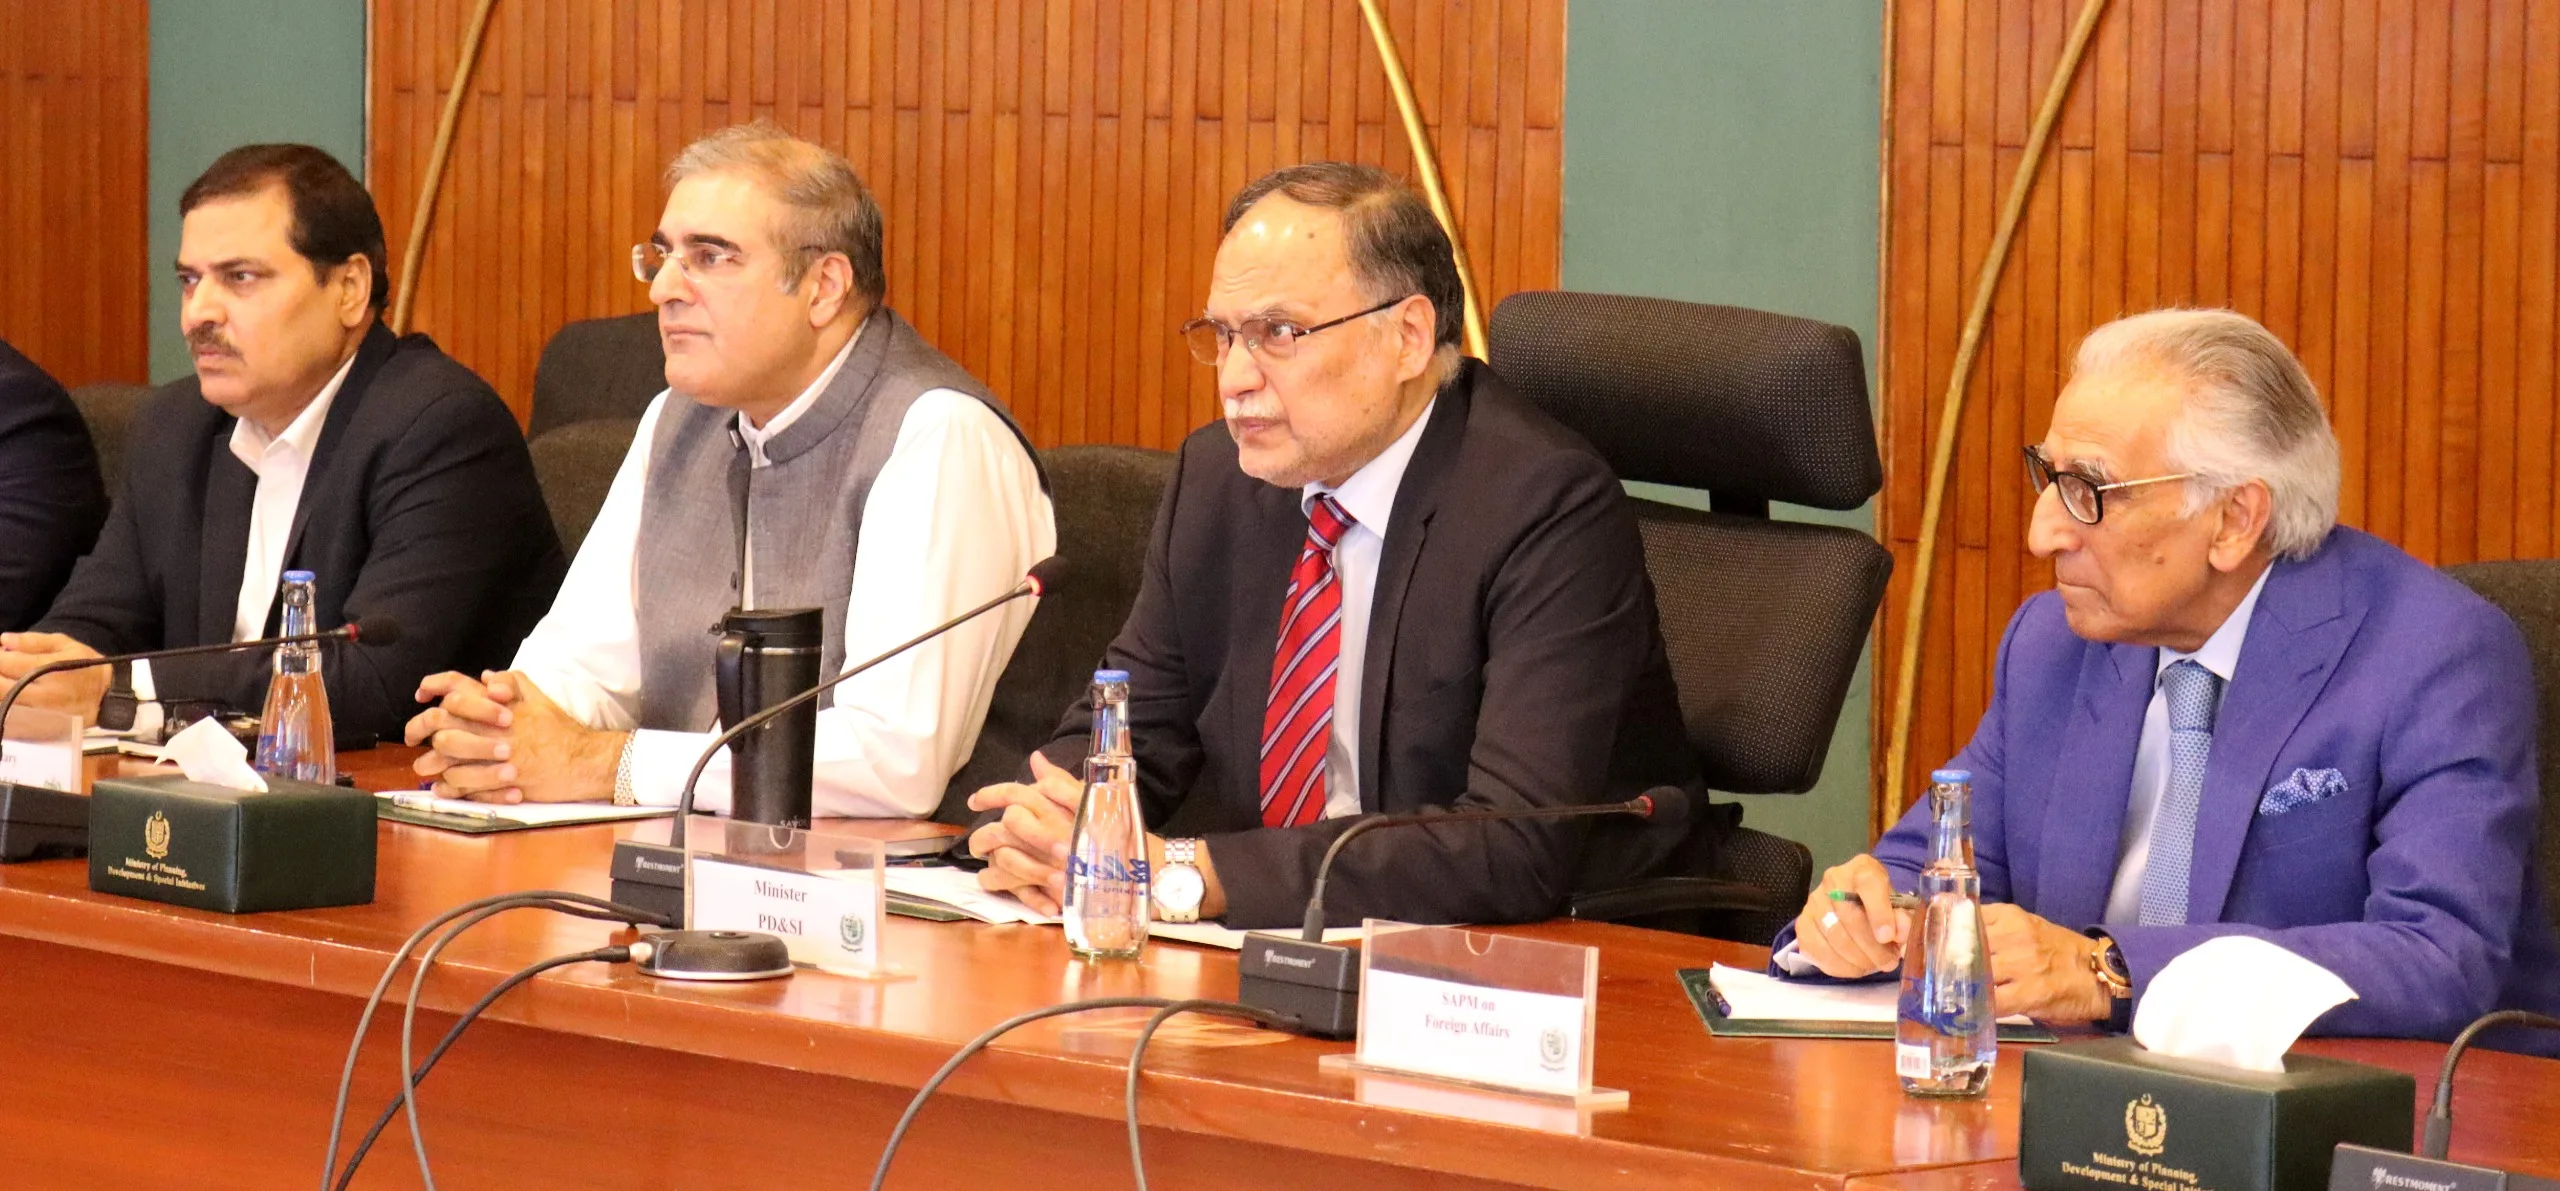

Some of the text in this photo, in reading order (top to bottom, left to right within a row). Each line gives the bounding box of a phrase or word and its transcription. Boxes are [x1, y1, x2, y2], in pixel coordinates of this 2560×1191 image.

[754, 879, 808, 902] Minister
[758, 913, 803, 936] PD&SI
[1441, 991, 1495, 1012] SAPM on
[1425, 1014, 1510, 1038] Foreign Affairs
[2061, 1161, 2127, 1183] Development
[2129, 1173, 2139, 1185] &
[2141, 1175, 2177, 1191] Special
[2092, 1151, 2198, 1184] Ministry of Planning,
